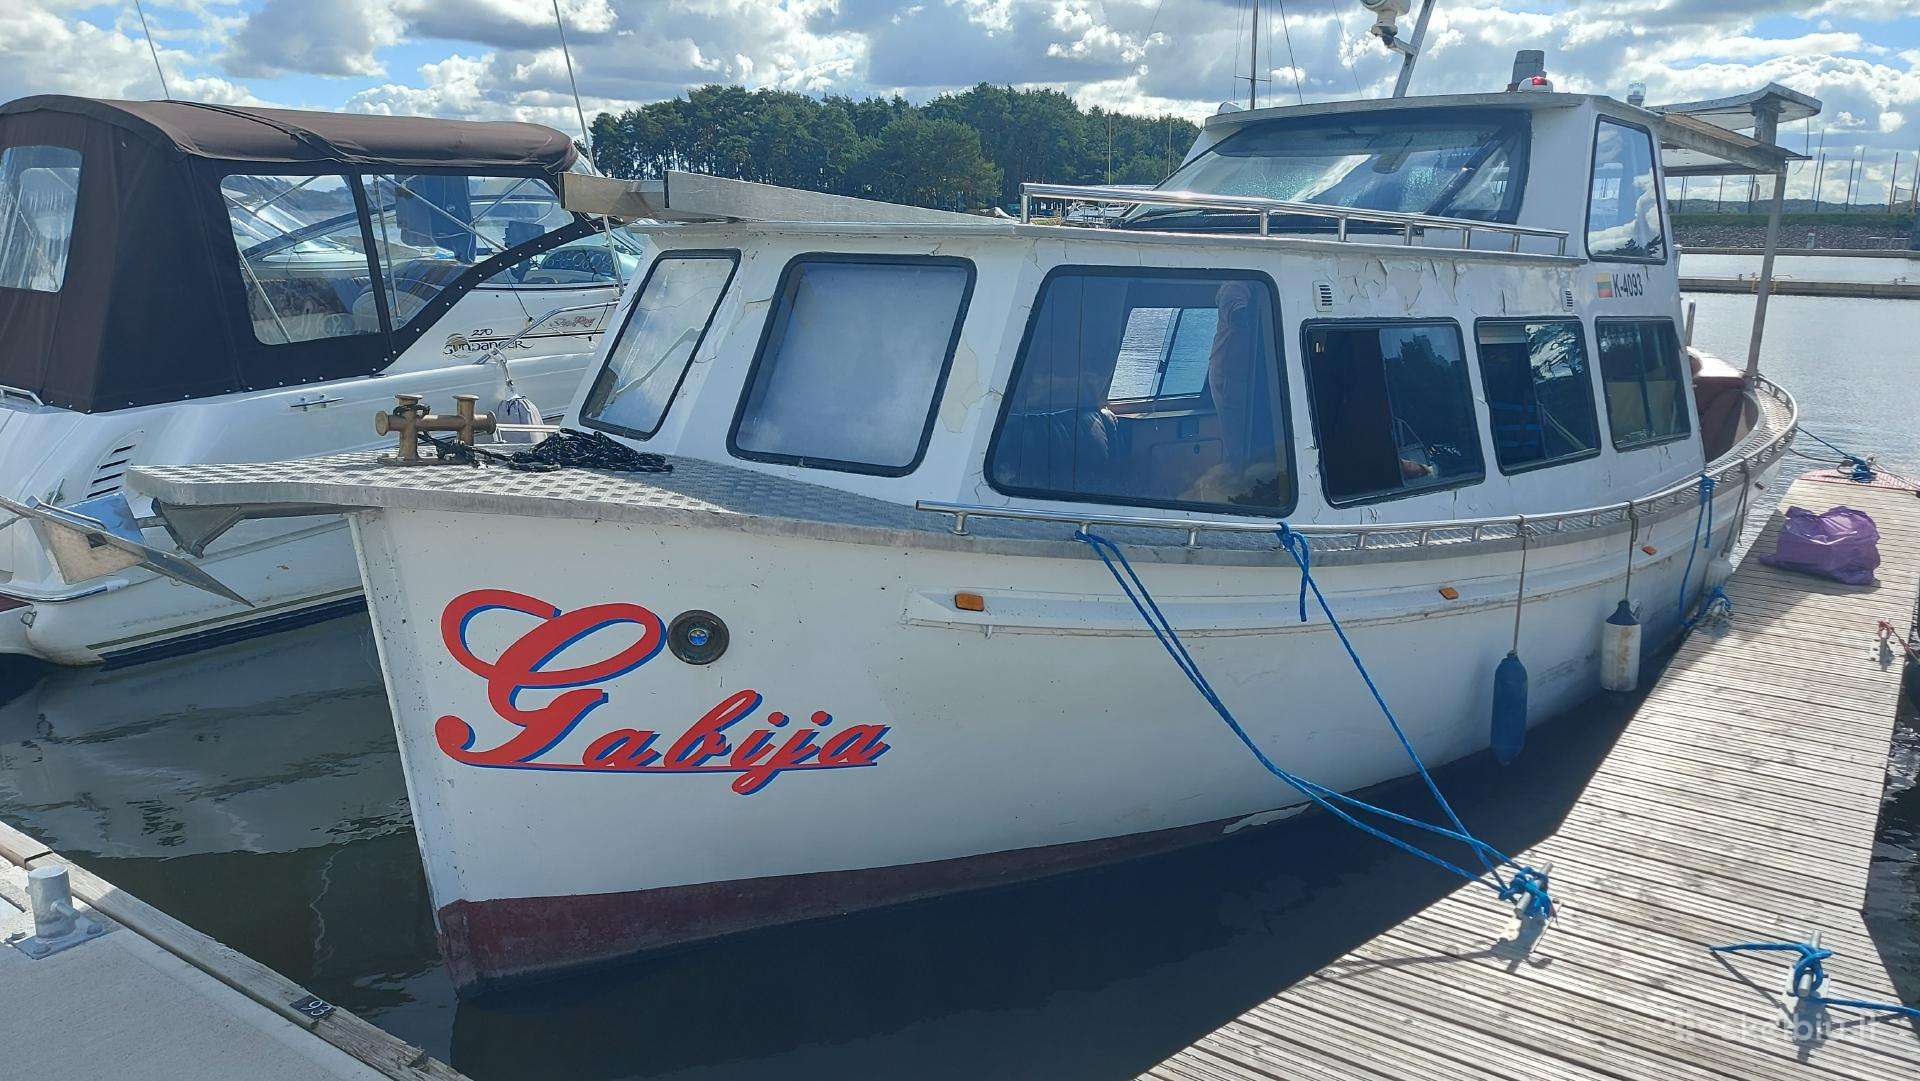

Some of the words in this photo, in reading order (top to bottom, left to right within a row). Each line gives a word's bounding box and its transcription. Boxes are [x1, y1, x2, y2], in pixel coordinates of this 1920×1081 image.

[1612, 272, 1643, 298] K-4093
[435, 589, 892, 795] Gabija
[301, 1000, 332, 1016] 93
